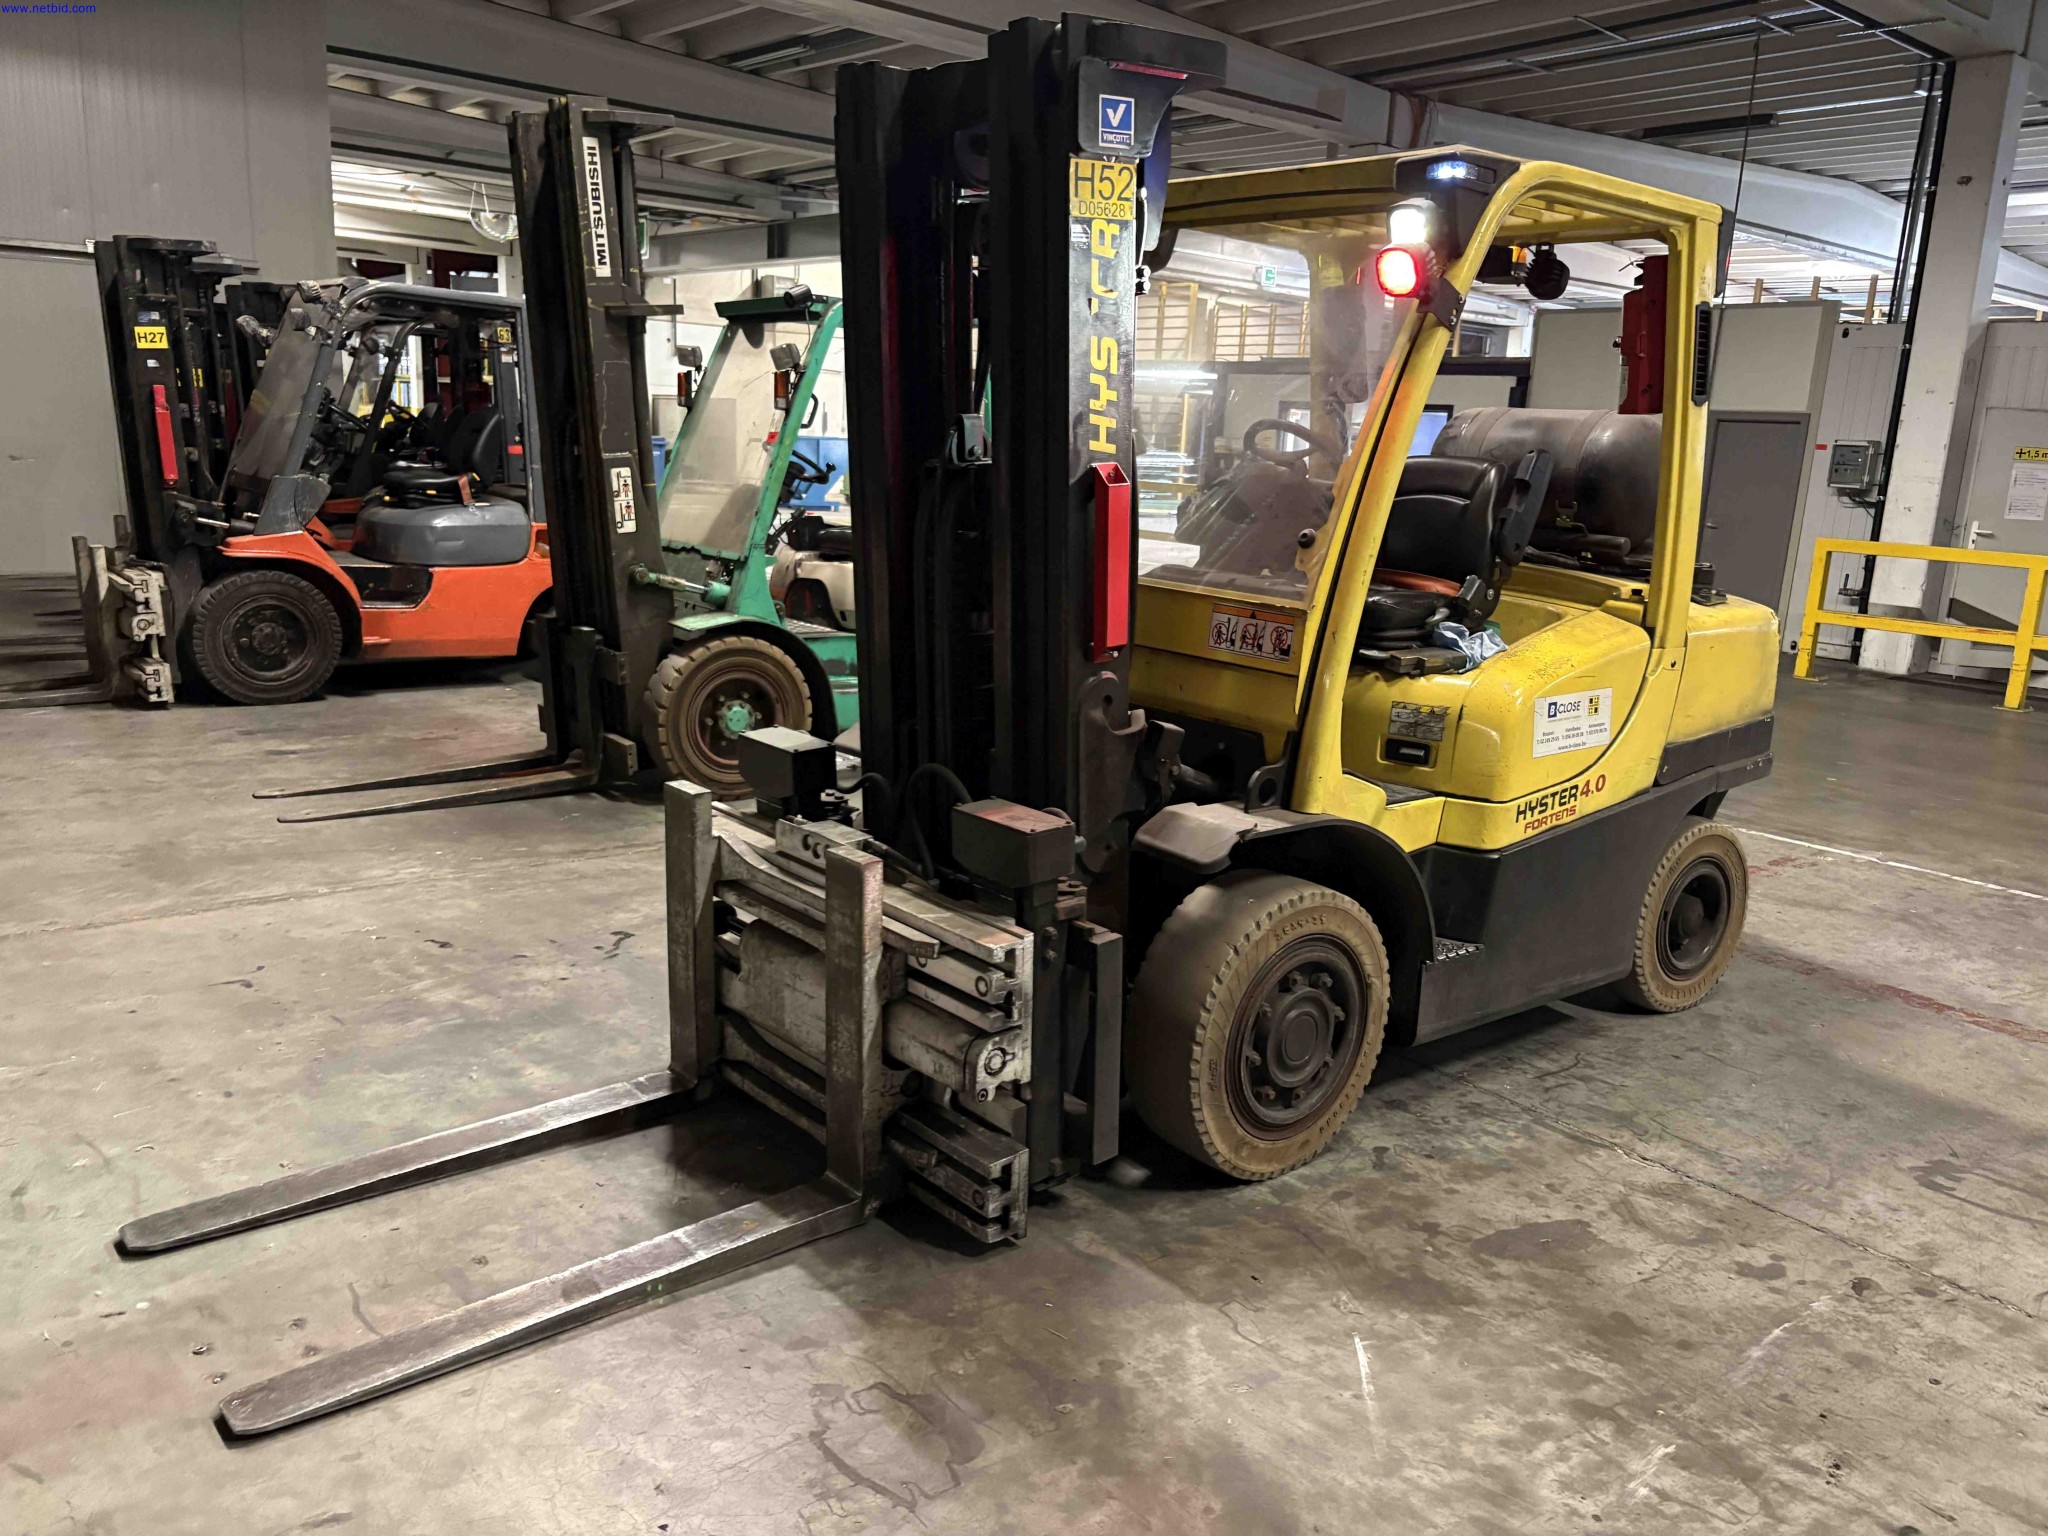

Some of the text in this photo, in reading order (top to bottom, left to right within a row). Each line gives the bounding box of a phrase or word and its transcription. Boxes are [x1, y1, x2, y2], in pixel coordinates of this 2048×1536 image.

[1074, 161, 1134, 202] H52
[586, 146, 608, 267] MITSUBISHI
[1079, 200, 1126, 218] D05628
[137, 332, 164, 343] H27
[1515, 773, 1606, 823] HYSTER 4.0
[1524, 805, 1577, 834] FORTENS
